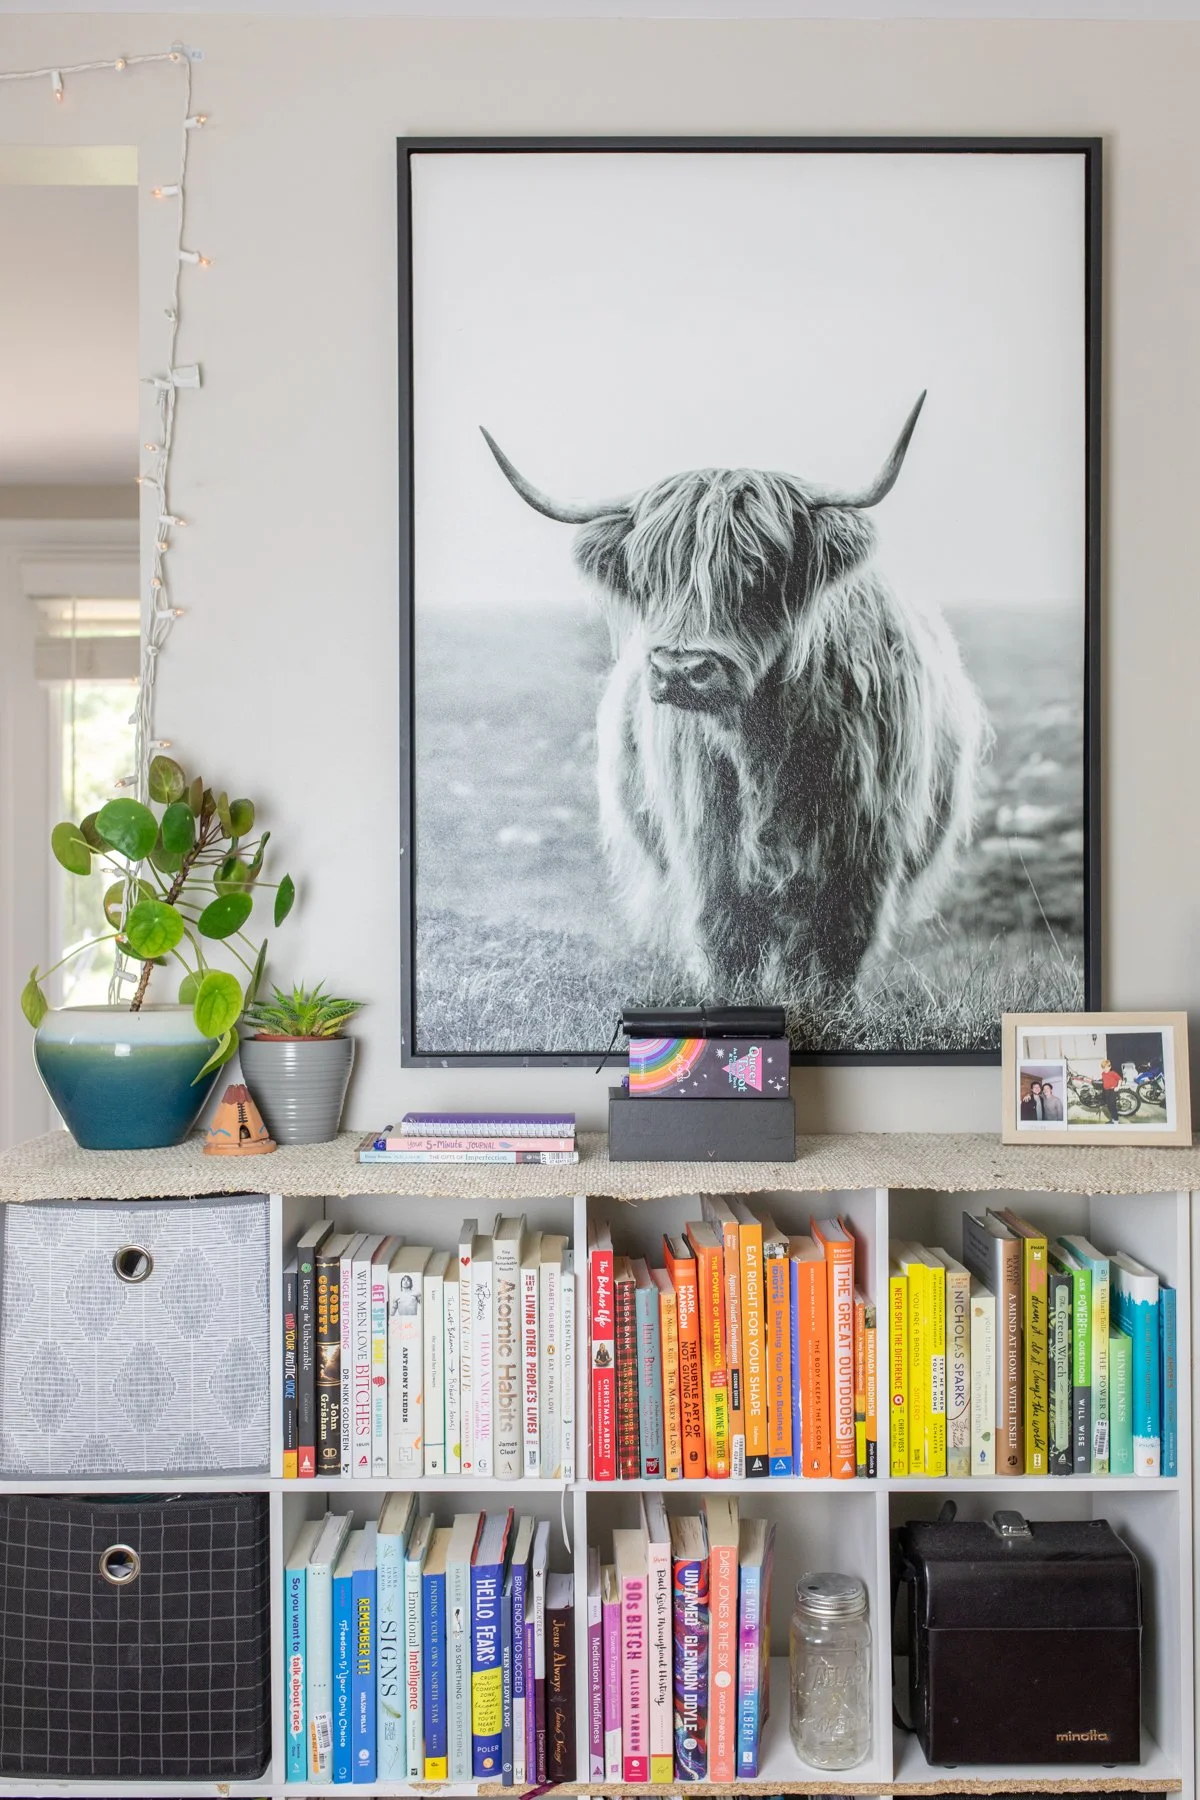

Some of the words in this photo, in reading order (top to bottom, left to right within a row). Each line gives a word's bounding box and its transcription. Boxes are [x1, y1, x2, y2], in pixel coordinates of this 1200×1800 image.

[737, 1058, 748, 1092] Tarot
[748, 1046, 759, 1085] Queer
[466, 1142, 496, 1150] JOURNAL
[600, 1260, 608, 1274] The
[746, 1246, 756, 1267] EAT
[342, 1270, 350, 1299] SINGLE
[358, 1270, 367, 1299] WHY
[597, 1275, 610, 1309] Badass
[712, 1271, 720, 1300] POWER
[748, 1271, 758, 1308] RIGHT
[838, 1268, 850, 1297] THE
[1009, 1293, 1016, 1301] A
[318, 1276, 328, 1335] COUNTY
[330, 1285, 339, 1324] FORD
[342, 1302, 350, 1319] BUT
[526, 1294, 535, 1325] LIVING
[679, 1285, 688, 1328] MANSON
[687, 1285, 695, 1313] MARK
[714, 1304, 719, 1317] OF
[1032, 1296, 1044, 1323] dream
[358, 1302, 367, 1327] MEN
[498, 1279, 516, 1357] Atomic
[594, 1309, 612, 1328] Life
[748, 1312, 758, 1335] FOR
[774, 1310, 783, 1348] Starting
[838, 1302, 851, 1350] GREAT
[954, 1291, 964, 1358] NICHOLAS
[1076, 1294, 1088, 1338] POWERFUL
[342, 1322, 350, 1349] DATING
[358, 1330, 368, 1360] LOVE
[526, 1328, 536, 1358] OTHER
[714, 1319, 722, 1366] INTENTION
[1009, 1334, 1016, 1347] AT
[1032, 1342, 1043, 1355] do
[750, 1339, 759, 1373] YOUR
[776, 1352, 784, 1372] Your
[1078, 1341, 1086, 1384] QUESTIONS
[342, 1369, 350, 1381] DR.
[526, 1362, 537, 1403] PEOPLE'S
[668, 1370, 676, 1384] THE
[691, 1362, 700, 1399] SUBTLE
[776, 1376, 784, 1398] Own
[954, 1363, 964, 1407] SPARKS
[1118, 1351, 1126, 1422] MINDFULNESS
[342, 1384, 350, 1406] NIKKI
[356, 1364, 370, 1435] BITCHES
[498, 1364, 518, 1432] Habits
[715, 1392, 724, 1404] DR.
[750, 1376, 760, 1416] SHAPE
[840, 1356, 852, 1436] OUTDOORS
[1032, 1402, 1044, 1417] the
[320, 1394, 330, 1440] Grisham
[331, 1403, 339, 1431] John
[342, 1407, 350, 1450] GOLDSTEIN
[527, 1407, 537, 1434] LIVES
[670, 1422, 676, 1432] OF
[694, 1424, 700, 1438] OF
[716, 1406, 724, 1429] WAYNE
[717, 1430, 725, 1438] W.
[717, 1440, 726, 1459] DYER
[719, 1551, 730, 1580] DAISY
[292, 1578, 300, 1591] So
[626, 1582, 642, 1609] 90s
[684, 1570, 699, 1626] UNTAMED
[746, 1578, 756, 1595] BIG
[290, 1593, 299, 1612] you
[476, 1579, 496, 1621] HELLO,
[719, 1582, 729, 1618] JONES
[745, 1600, 756, 1630] MAGIC
[358, 1598, 370, 1656] REMEMBER
[408, 1592, 419, 1647] Emotional
[553, 1620, 566, 1648] Jesus
[719, 1620, 728, 1630] &
[293, 1641, 300, 1652] to
[476, 1625, 496, 1662] FEARS
[516, 1640, 522, 1652] TO
[626, 1614, 642, 1660] BITCH
[718, 1632, 728, 1650] THE
[294, 1657, 302, 1675] talk
[357, 1660, 370, 1675] IT!
[380, 1620, 398, 1697] SIGNS
[550, 1651, 566, 1692] Always
[592, 1638, 600, 1682] Meditation
[684, 1636, 698, 1690] GLENNON
[718, 1653, 728, 1668] SIX
[744, 1642, 755, 1696] ELIZABETH
[294, 1678, 302, 1708] about
[408, 1650, 420, 1710] Intelligence
[630, 1669, 640, 1709] ALLISON
[594, 1693, 602, 1744] Mindfulness
[684, 1694, 698, 1732] DOYLE
[744, 1700, 754, 1742] GILBERT
[631, 1714, 640, 1752] YARROW
[1056, 1730, 1109, 1742] minolta
